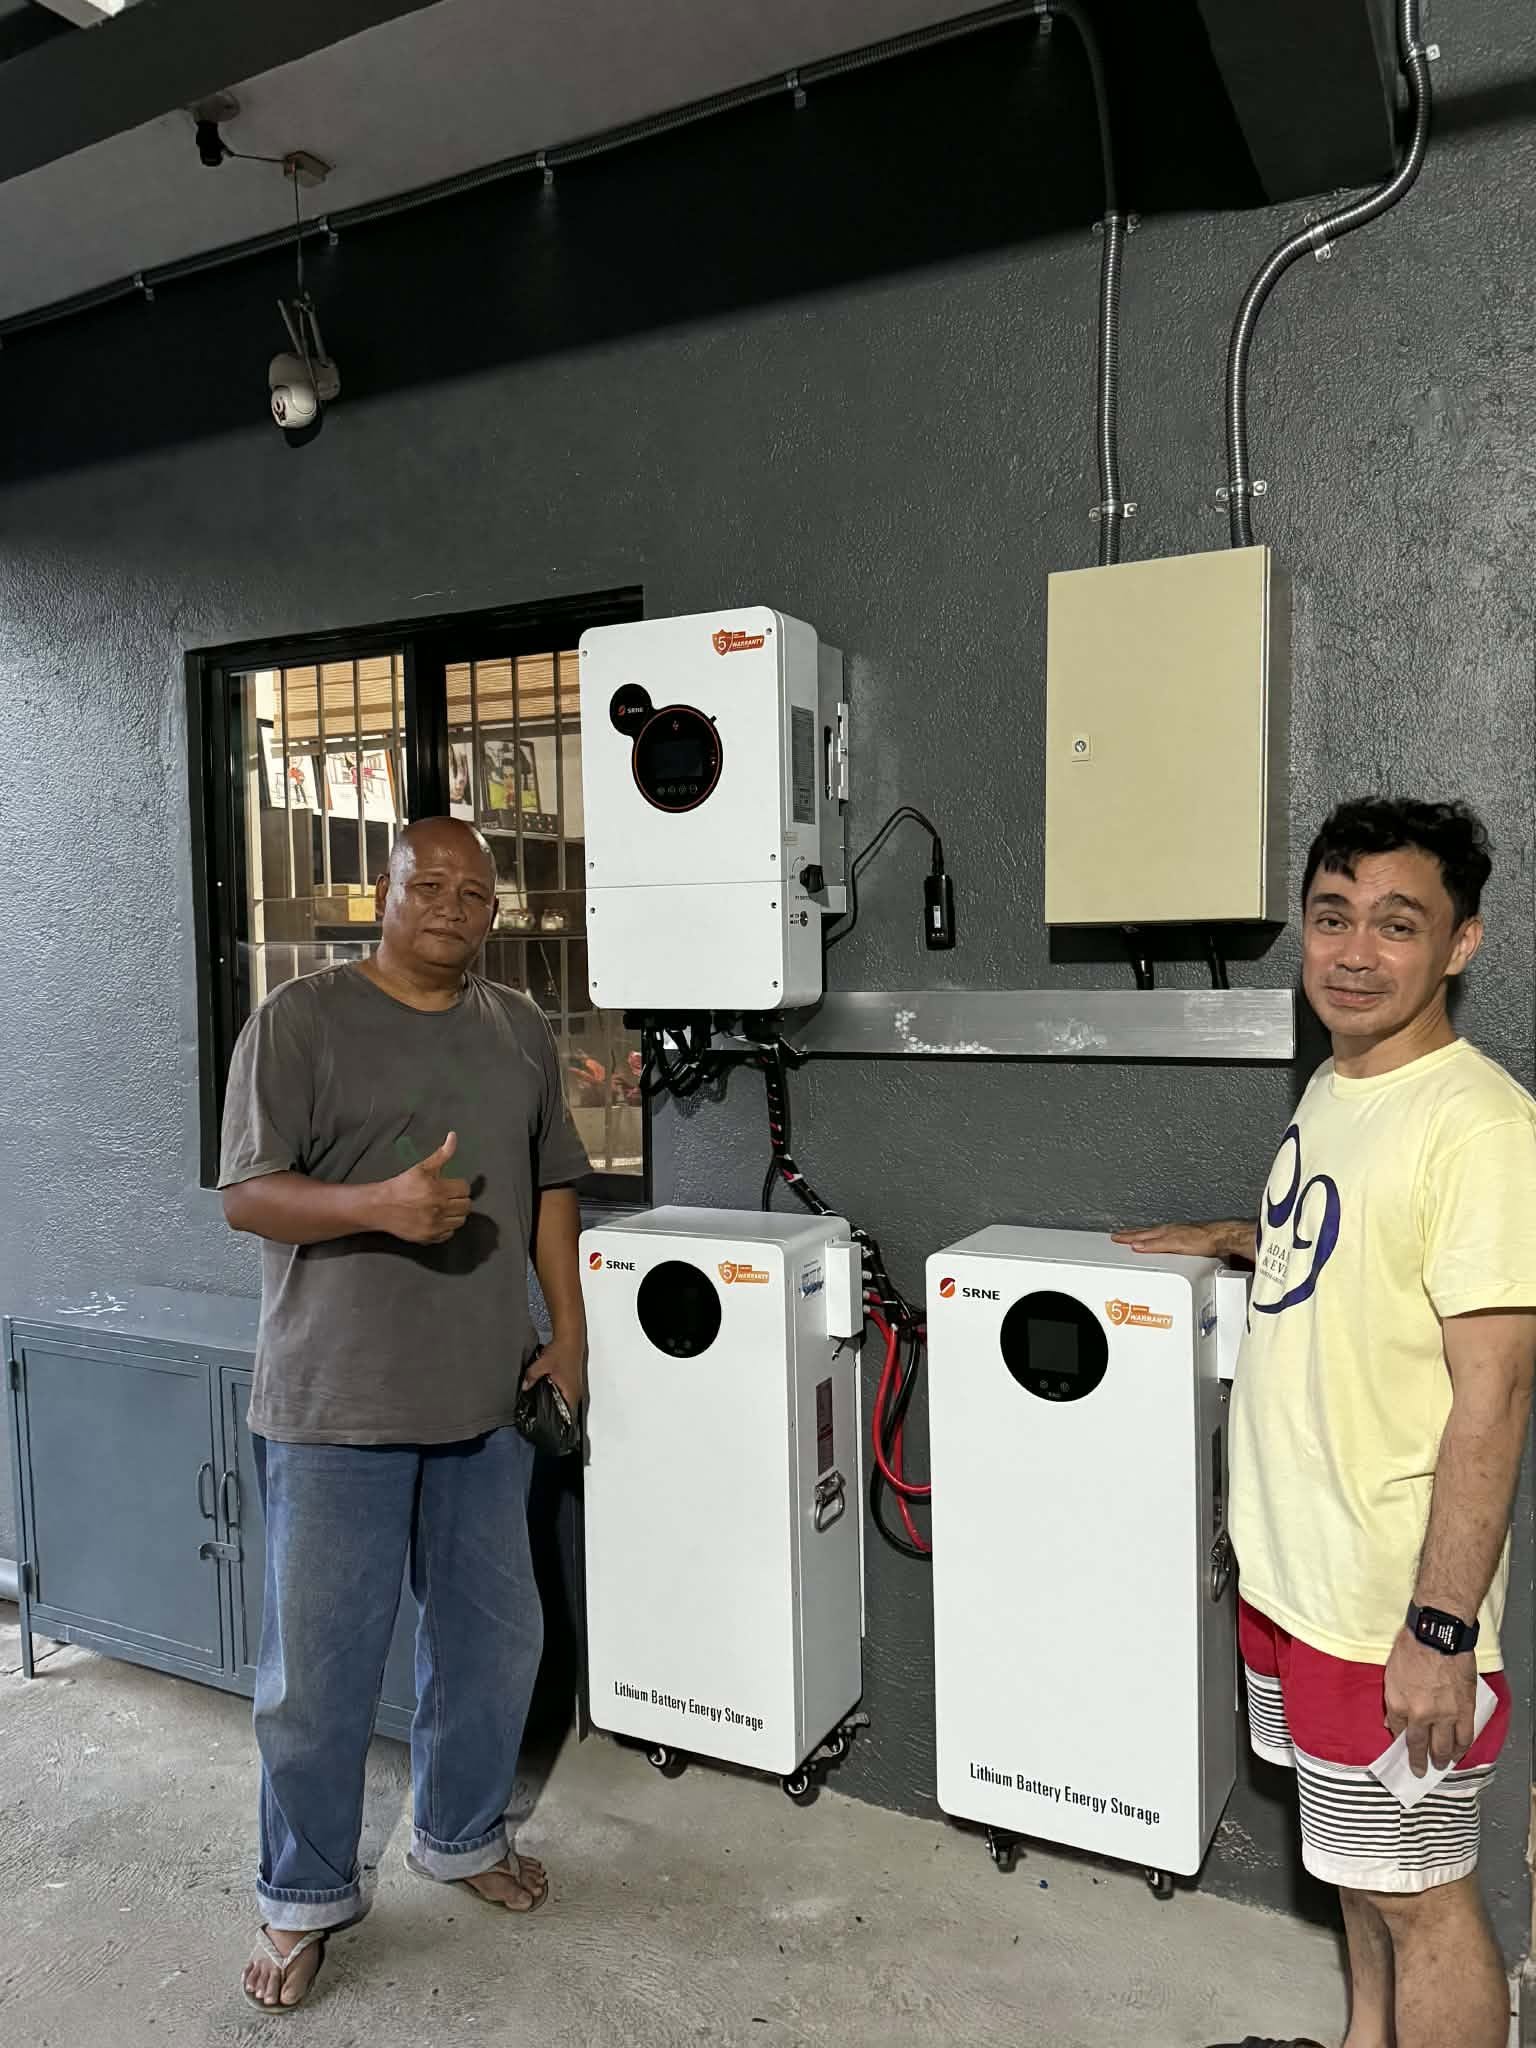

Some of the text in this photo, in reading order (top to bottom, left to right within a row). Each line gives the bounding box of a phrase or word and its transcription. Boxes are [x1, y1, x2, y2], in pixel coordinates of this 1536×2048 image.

[717, 636, 764, 651] 5 WARRANTY
[606, 1260, 636, 1271] SRNE
[723, 1265, 733, 1280] 5
[962, 1287, 1001, 1301] SRNE
[1111, 1302, 1172, 1325] 5 WARRANTY
[614, 1681, 764, 1731] Lithium Battery Energy Storage
[970, 1762, 1160, 1825] Lithium Battery Energy Storage
